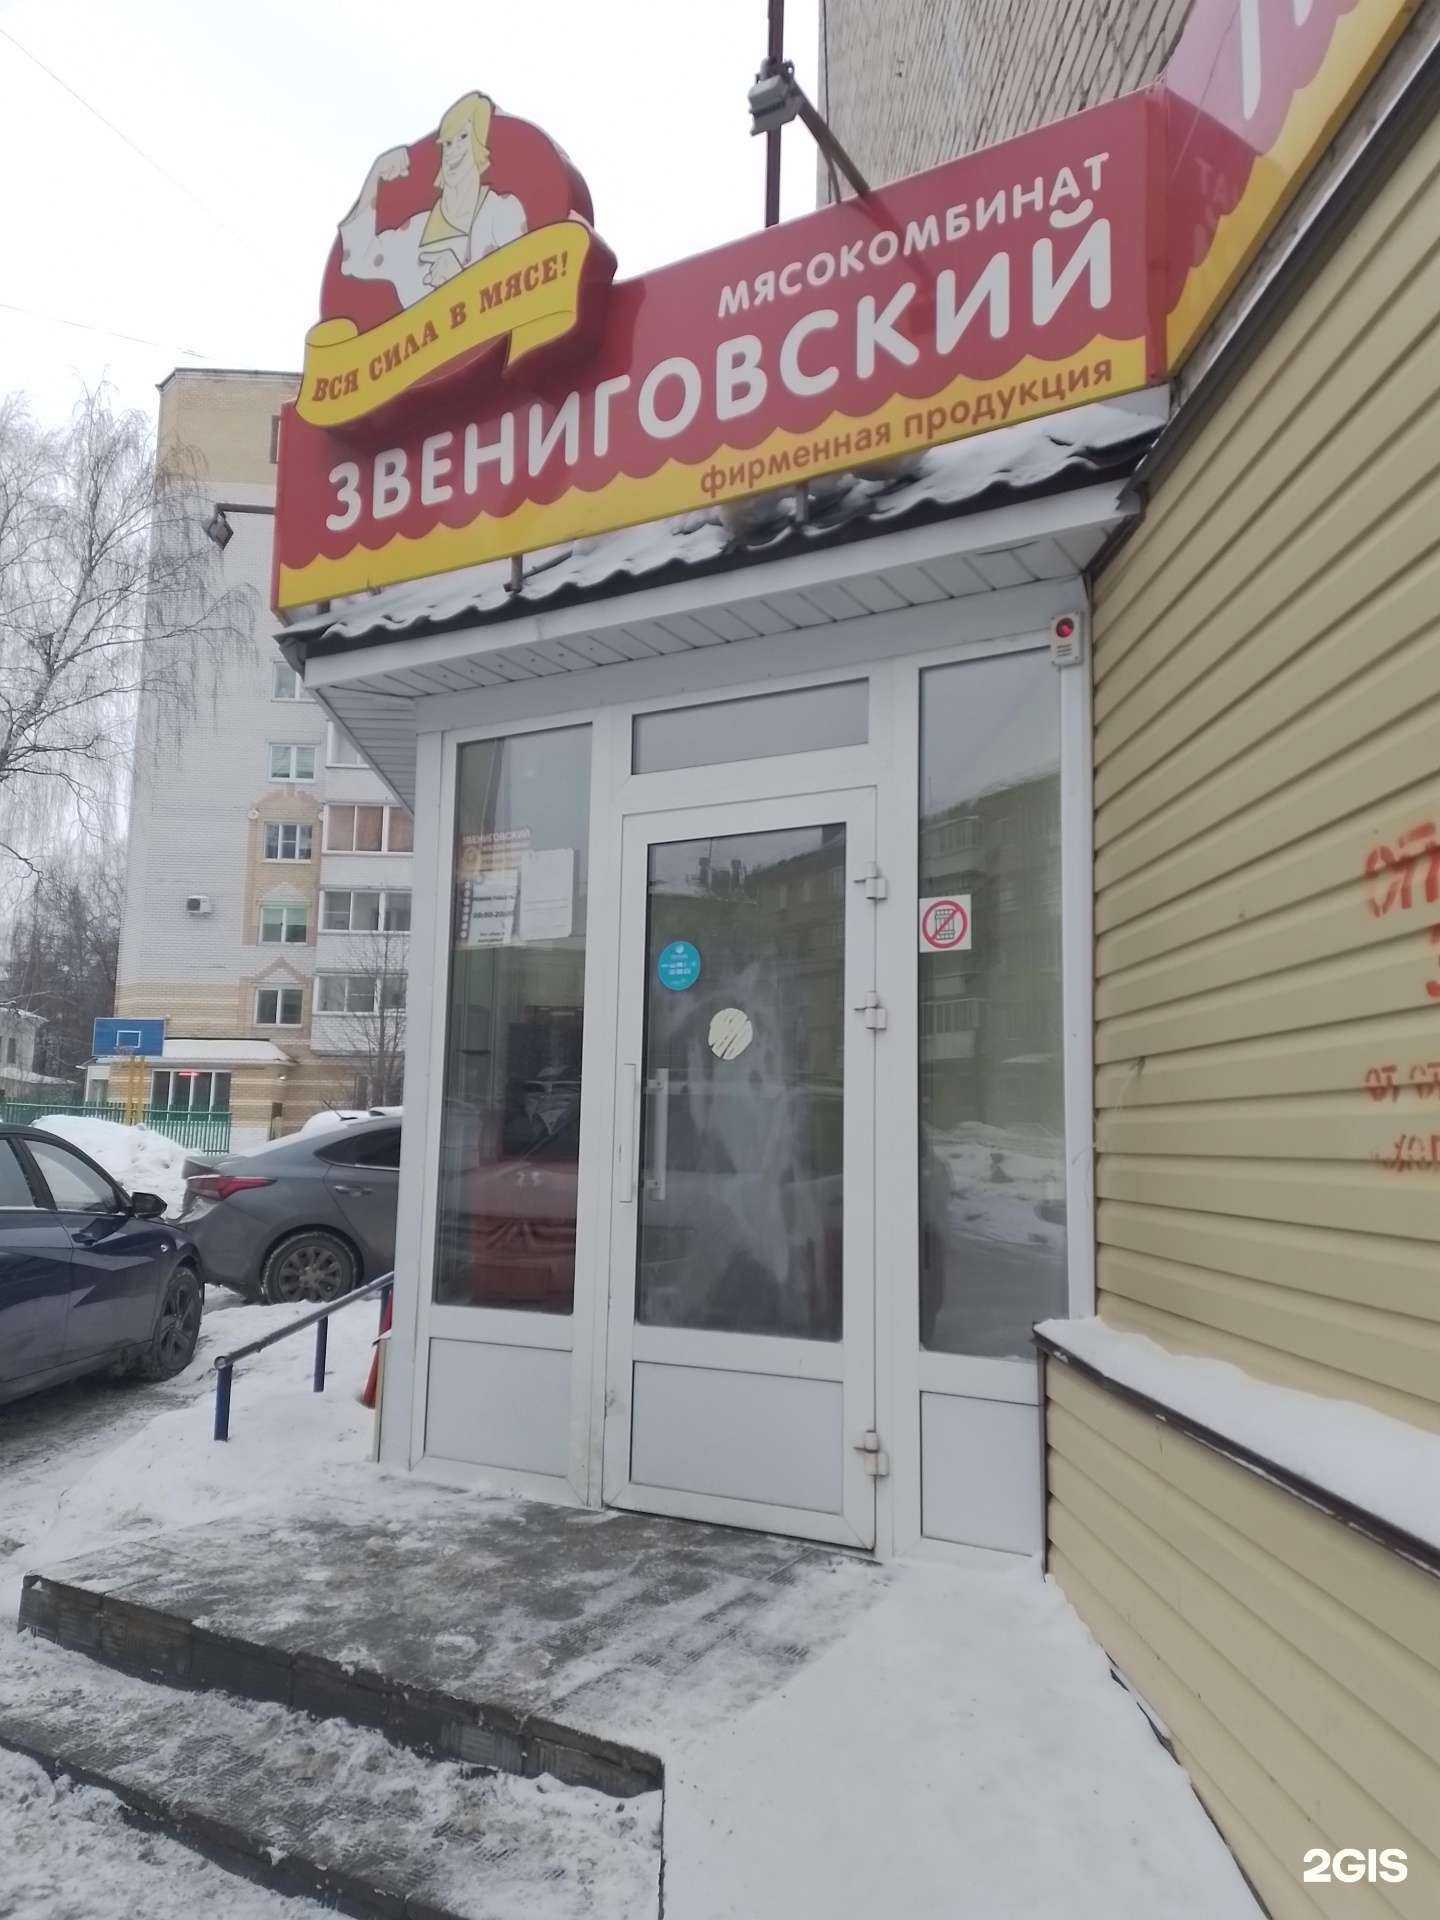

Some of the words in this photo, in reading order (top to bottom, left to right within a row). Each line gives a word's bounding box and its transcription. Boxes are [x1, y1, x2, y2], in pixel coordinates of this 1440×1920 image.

[718, 152, 1109, 318] МЯСОКОМБИНАТ
[312, 367, 359, 402] ВСЯ
[368, 320, 439, 381] СИЛА
[449, 301, 467, 330] В
[479, 251, 568, 313] МЯСЕ!
[326, 199, 1112, 532] ЗВЕНИГОВСКИЙ
[701, 421, 892, 497] фирменная
[903, 358, 1113, 439] продукция
